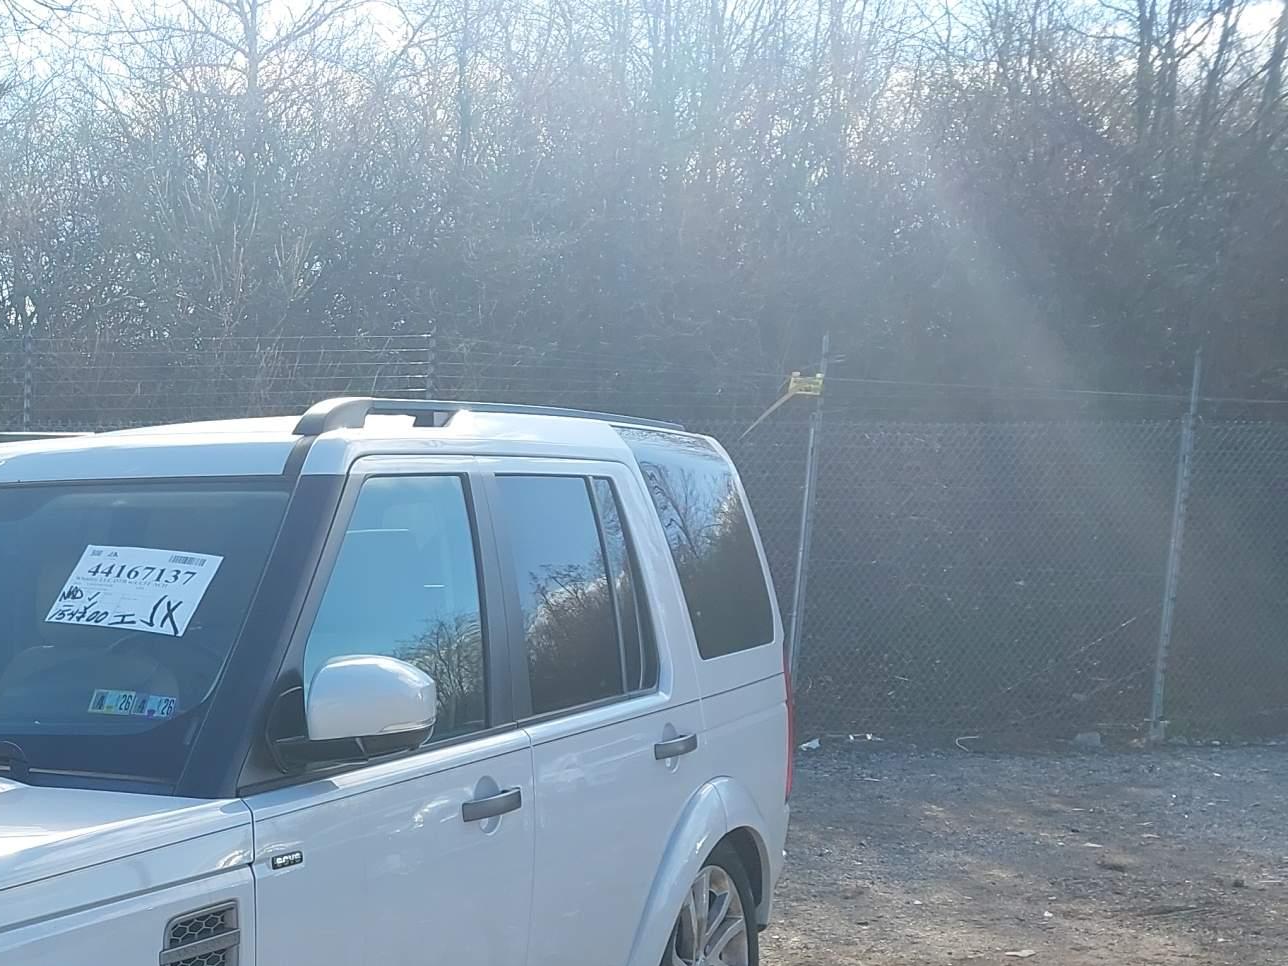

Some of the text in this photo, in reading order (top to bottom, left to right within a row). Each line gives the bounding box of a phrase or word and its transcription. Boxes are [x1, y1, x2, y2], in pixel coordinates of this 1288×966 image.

[87, 562, 197, 585] 44167137
[118, 694, 132, 711] 26
[161, 698, 175, 715] 26
